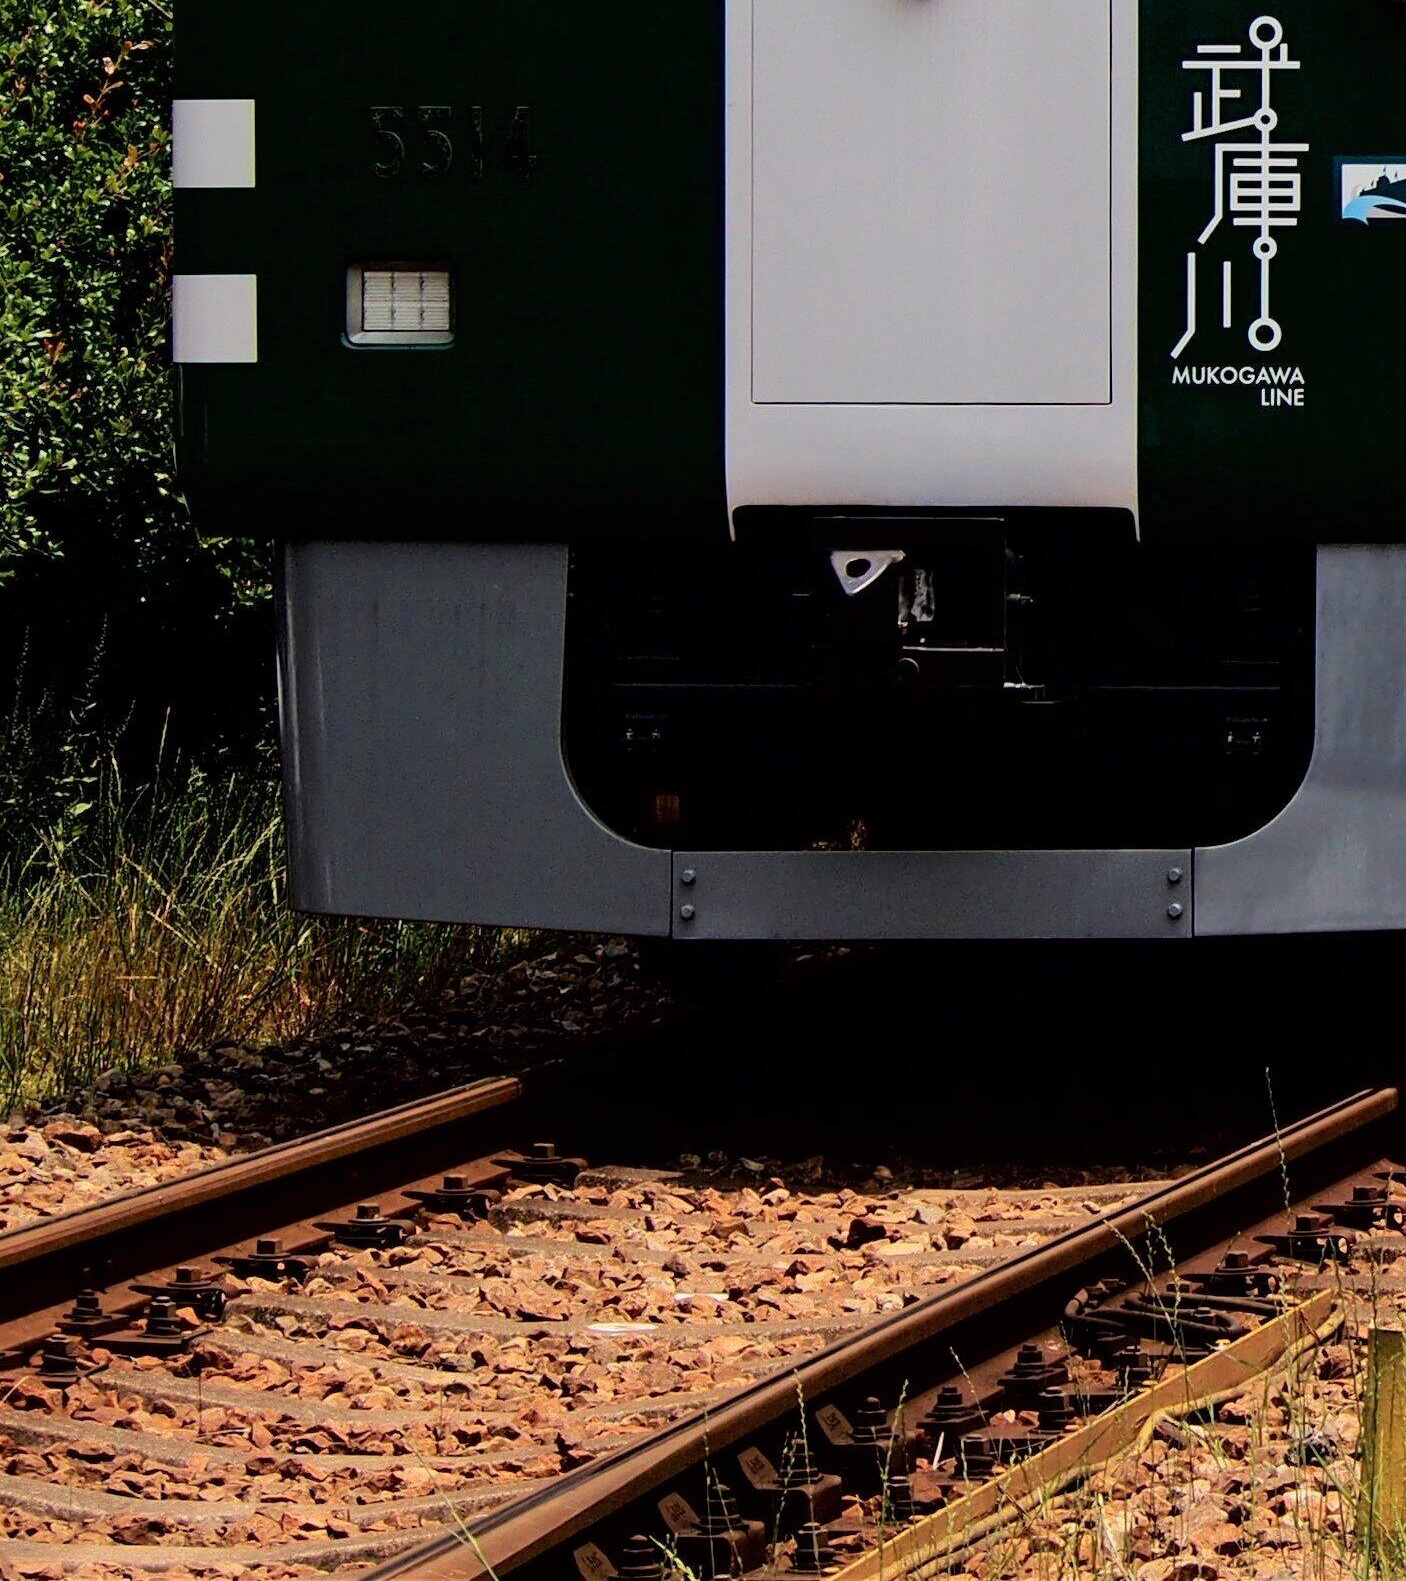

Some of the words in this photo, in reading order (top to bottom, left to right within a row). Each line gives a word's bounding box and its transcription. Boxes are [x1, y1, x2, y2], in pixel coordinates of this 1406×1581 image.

[368, 105, 541, 179] 5514
[1169, 15, 1310, 360] 武庫川
[1171, 365, 1305, 385] MUKOGAWA
[1260, 388, 1305, 407] LINE
